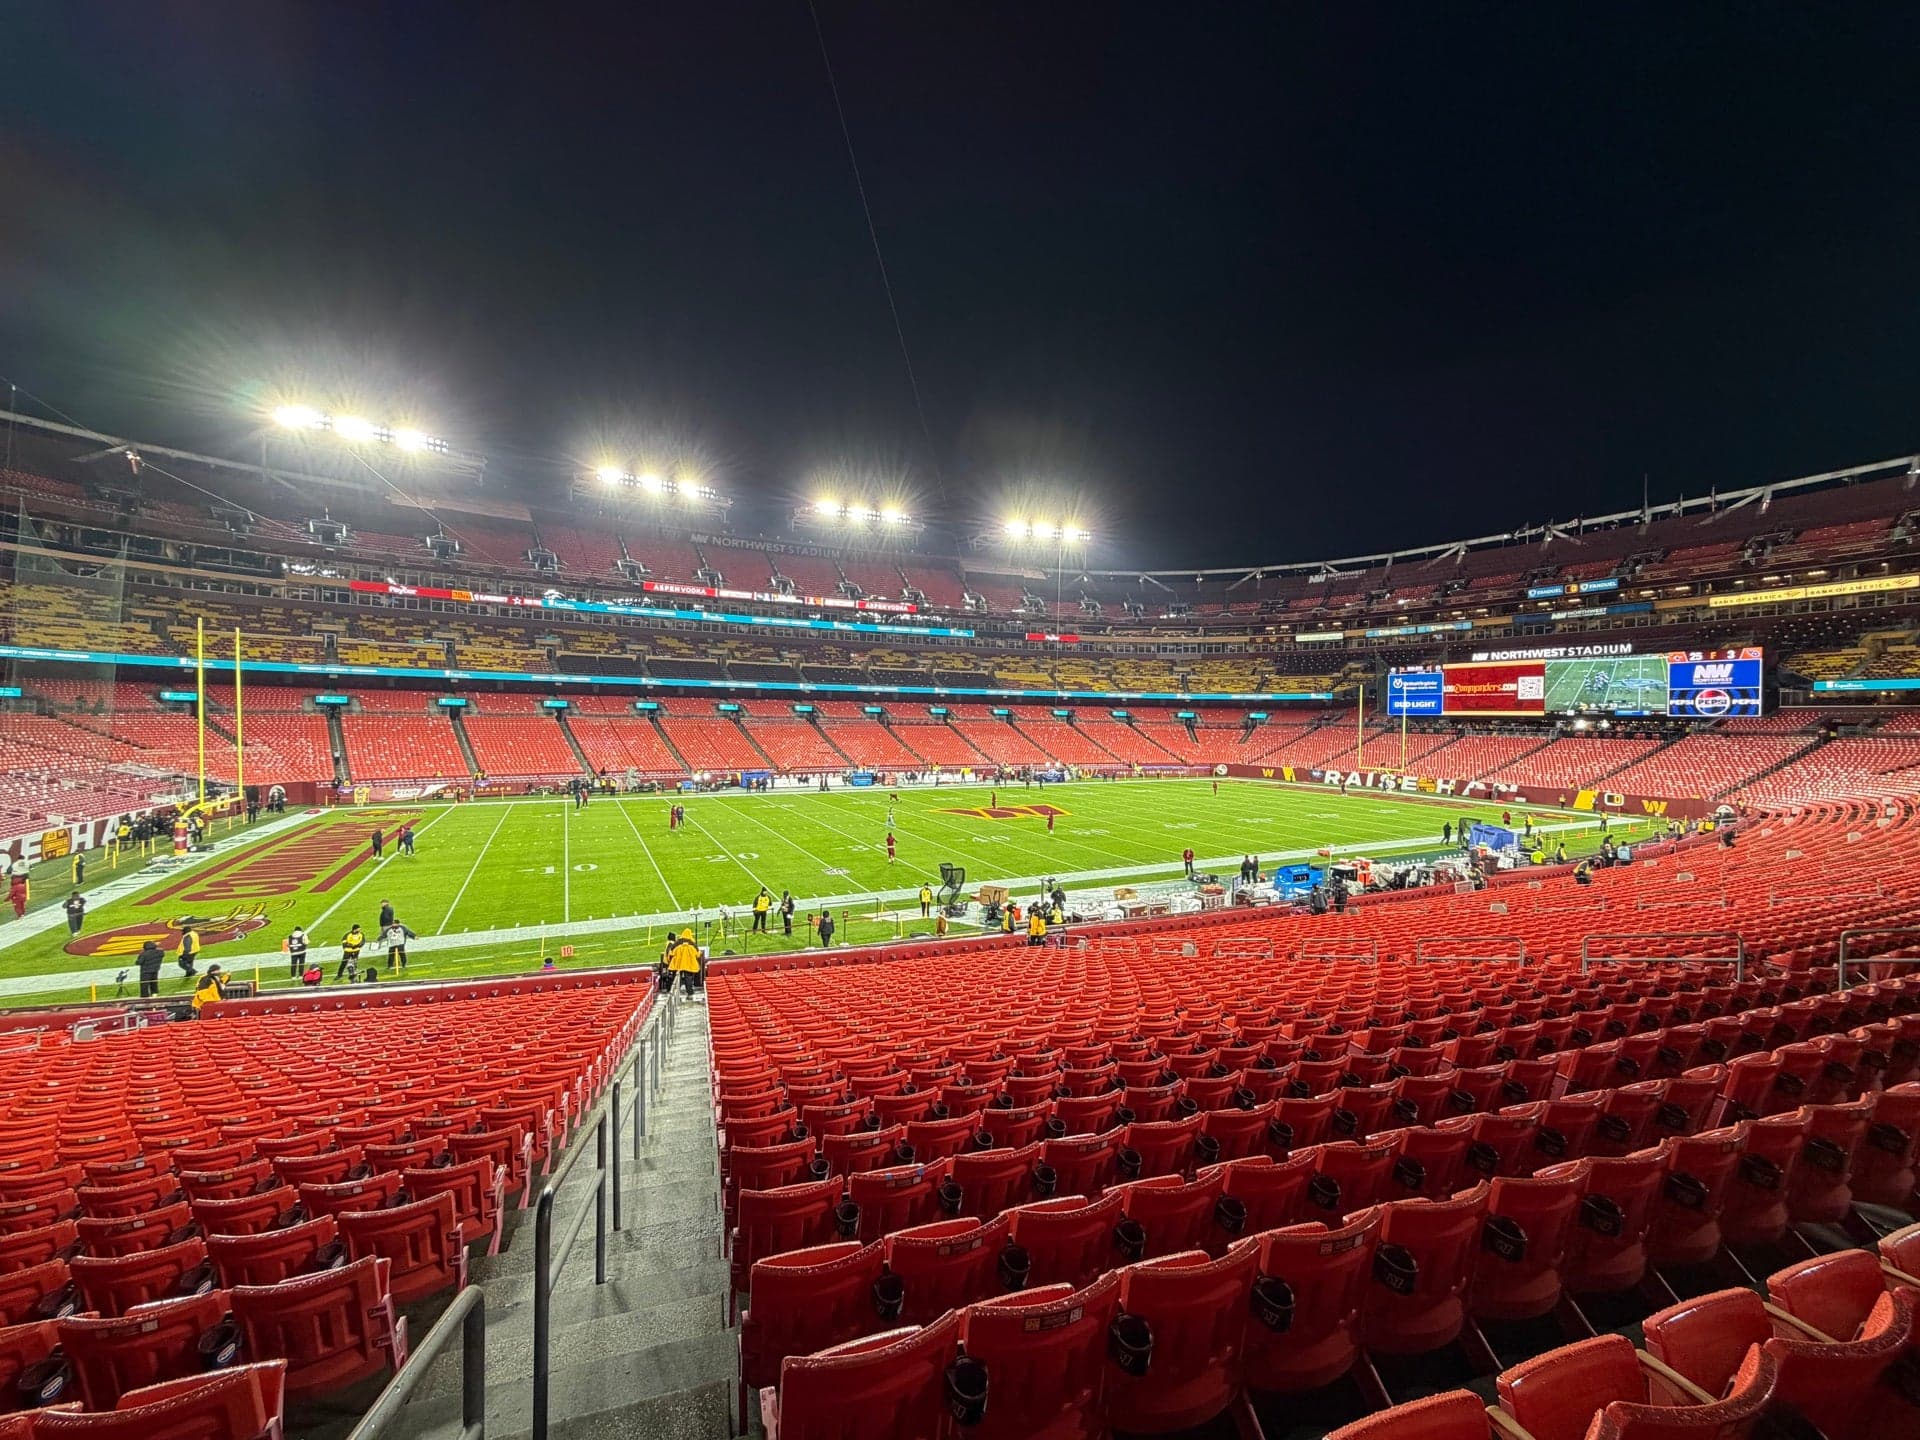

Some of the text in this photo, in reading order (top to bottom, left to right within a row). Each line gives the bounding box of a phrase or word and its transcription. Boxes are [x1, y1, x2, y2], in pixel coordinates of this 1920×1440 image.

[712, 536, 786, 553] NORTHWEST
[788, 545, 841, 559] STADIUM
[653, 584, 707, 595] ASPEN VODKA
[1849, 582, 1890, 591] AMERICA
[1491, 647, 1567, 660] NORTHWEST
[1568, 643, 1632, 656] STADIUM
[1689, 651, 1704, 660] 25
[1727, 650, 1735, 659] 3
[1693, 663, 1734, 678] NW
[1324, 769, 1419, 792] RAISE
